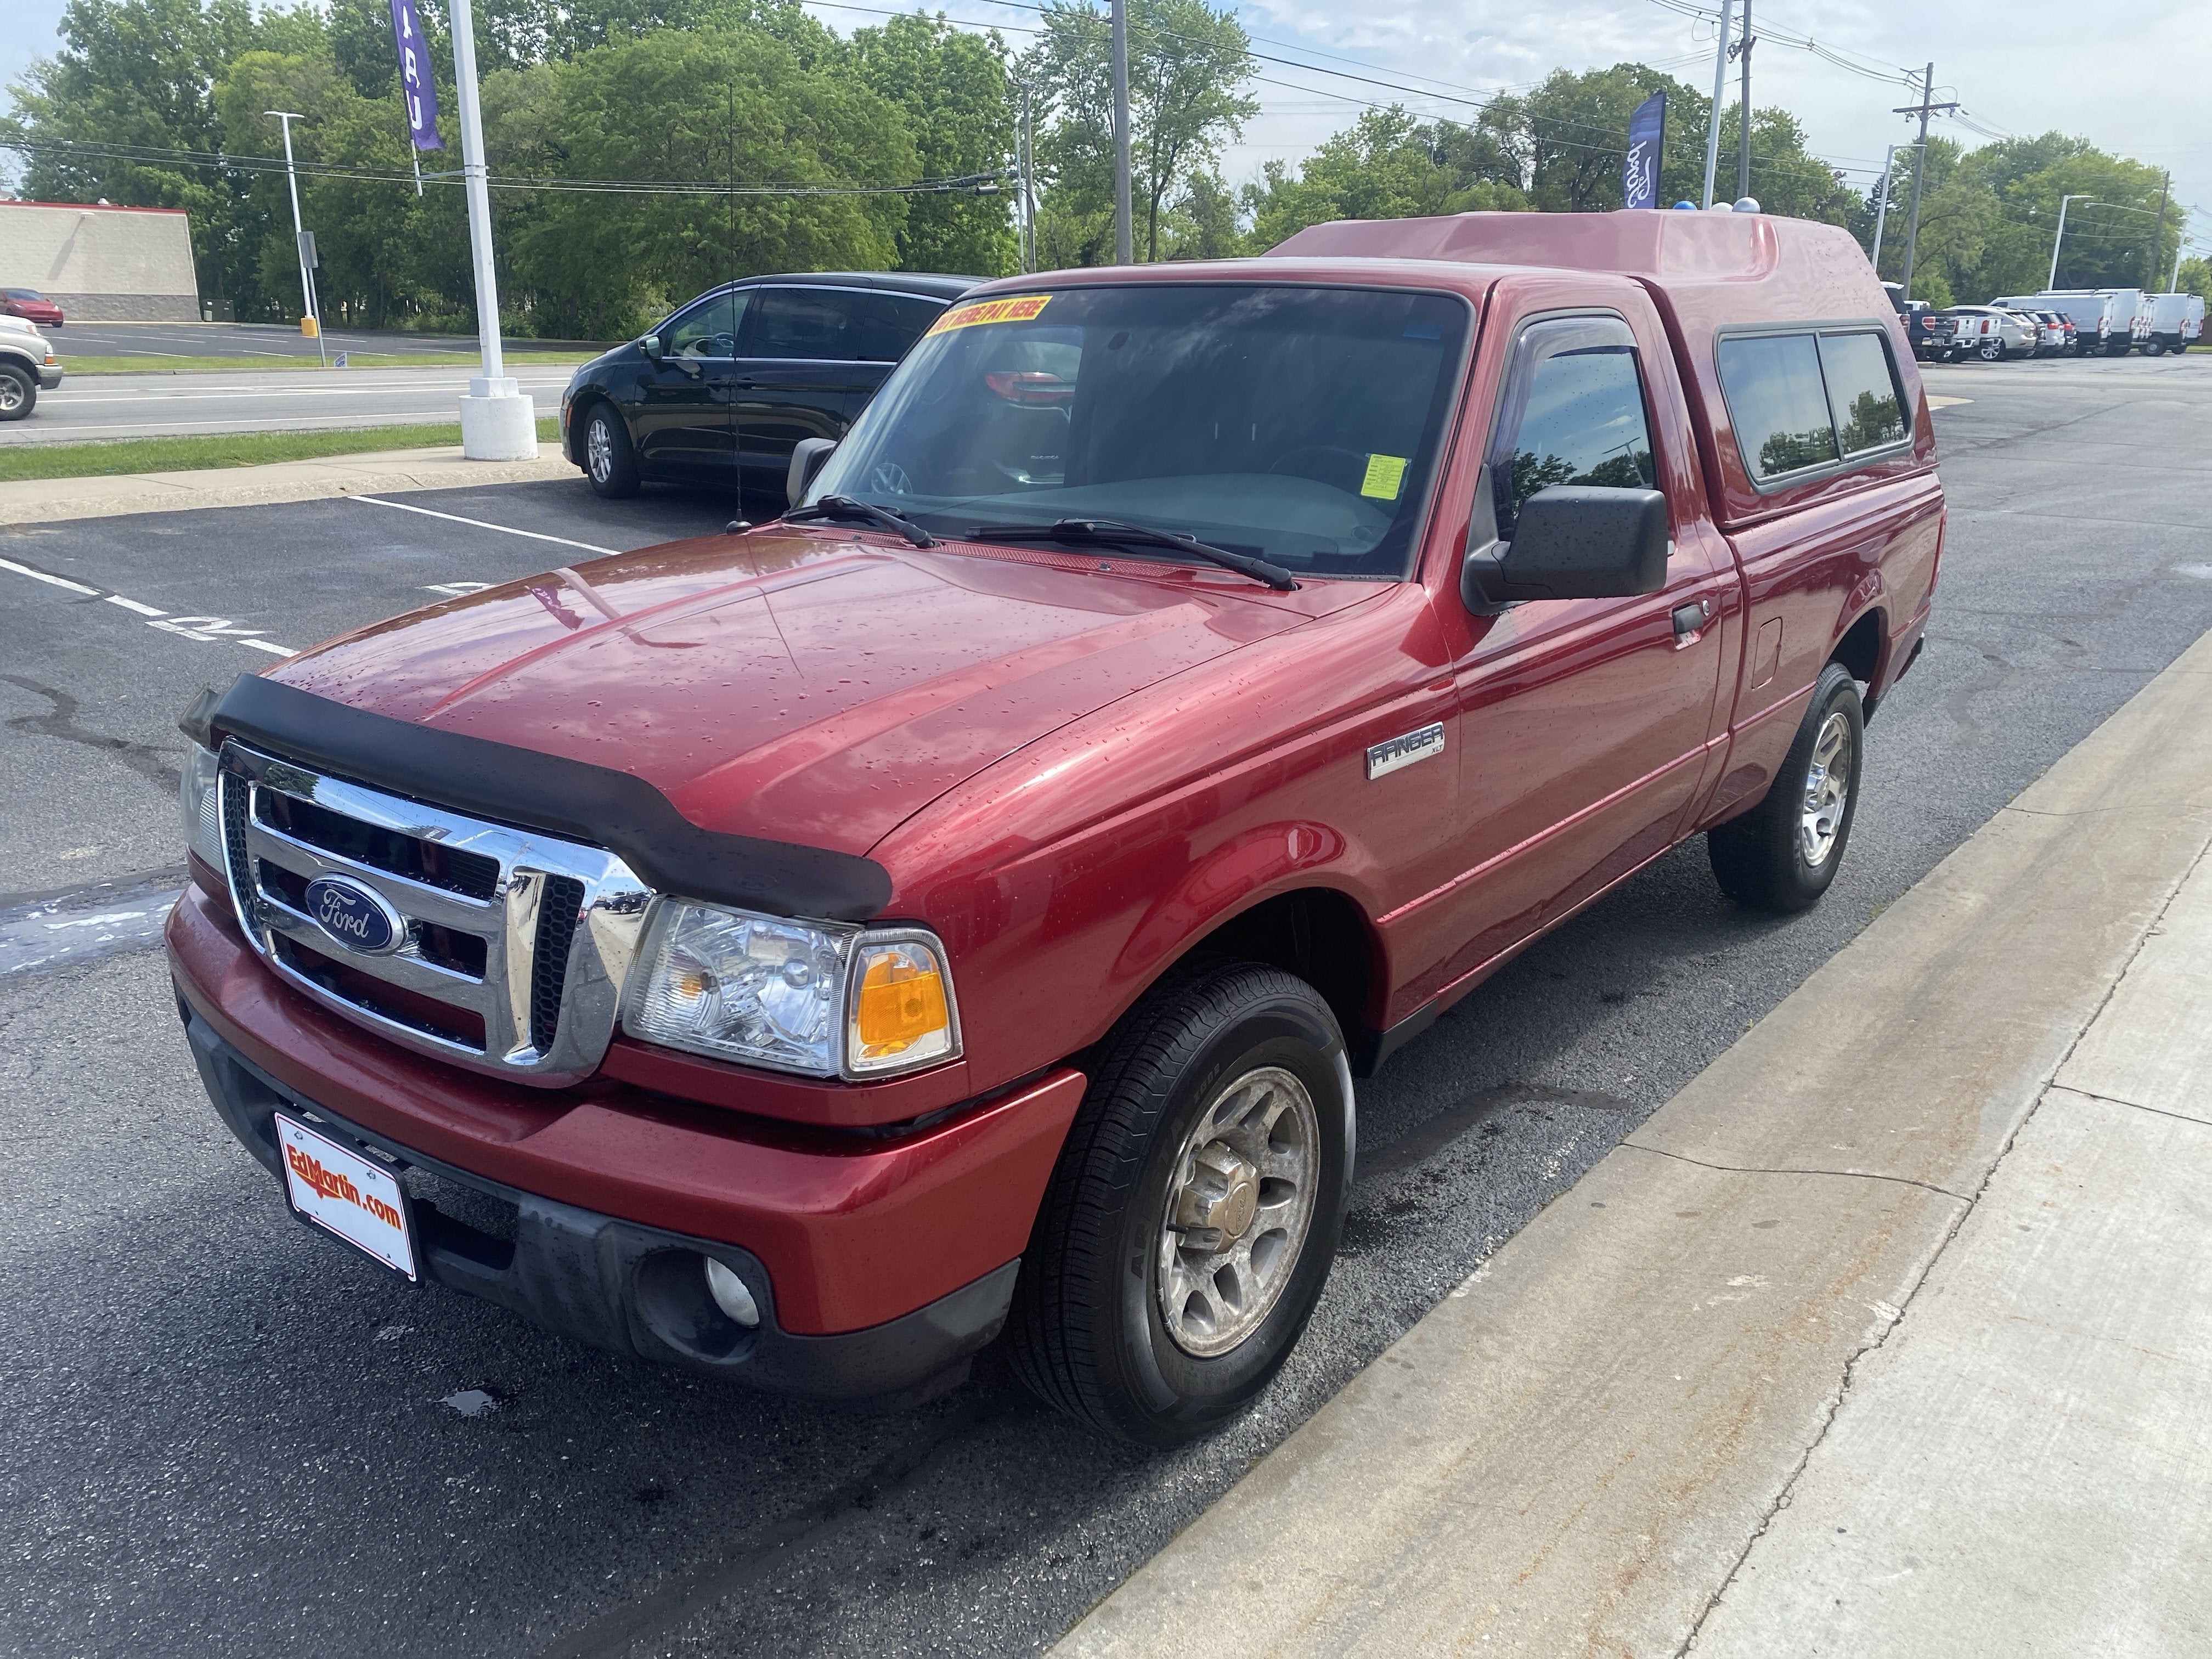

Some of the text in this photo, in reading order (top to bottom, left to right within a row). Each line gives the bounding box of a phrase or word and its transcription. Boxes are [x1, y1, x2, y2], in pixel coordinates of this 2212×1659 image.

[1626, 140, 1651, 208] Ford
[1005, 299, 1047, 319] HERE
[1370, 724, 1444, 767] RANGER
[1431, 744, 1443, 754] XLT
[319, 888, 370, 939] Ford
[286, 1142, 402, 1232] EdMartin.com
